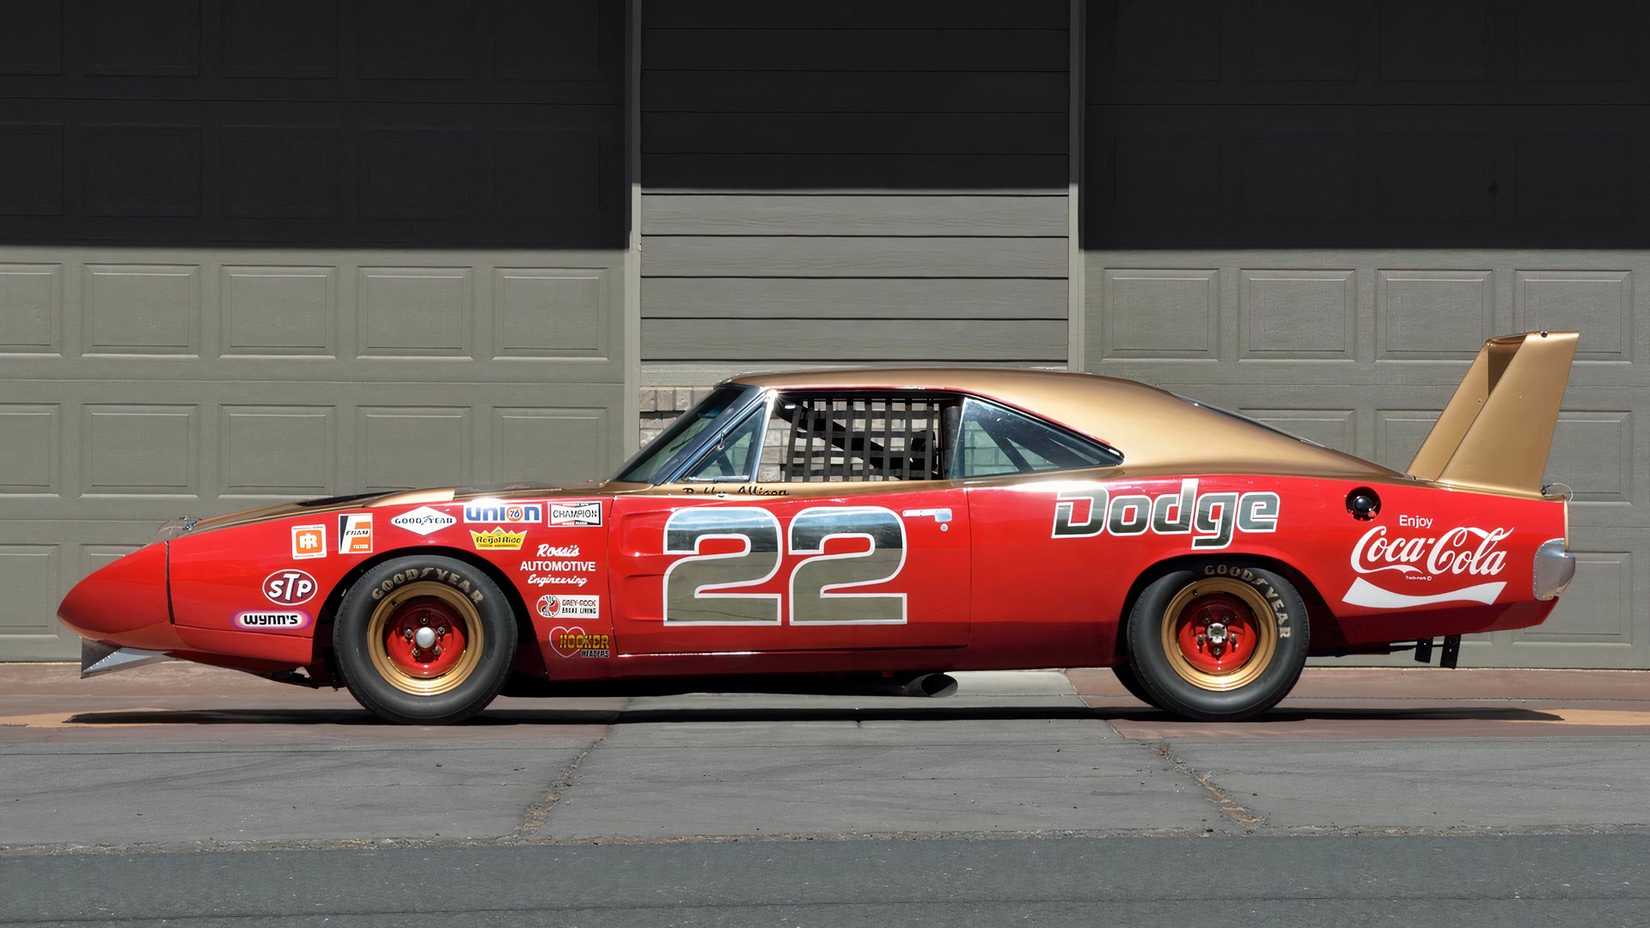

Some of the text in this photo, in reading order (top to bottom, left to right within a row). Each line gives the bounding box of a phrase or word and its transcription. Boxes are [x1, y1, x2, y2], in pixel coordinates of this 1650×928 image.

[737, 485, 790, 497] Allison
[552, 508, 598, 519] CHAMPION
[1051, 478, 1281, 551] Dodge
[1399, 515, 1433, 529] Enjoy
[1350, 525, 1515, 576] Coca-Cola
[520, 560, 596, 572] AUTOMOTIVE
[663, 506, 908, 627] 22
[268, 573, 312, 601] STP
[527, 573, 588, 587] Engineering
[559, 634, 609, 649] HOOKER
